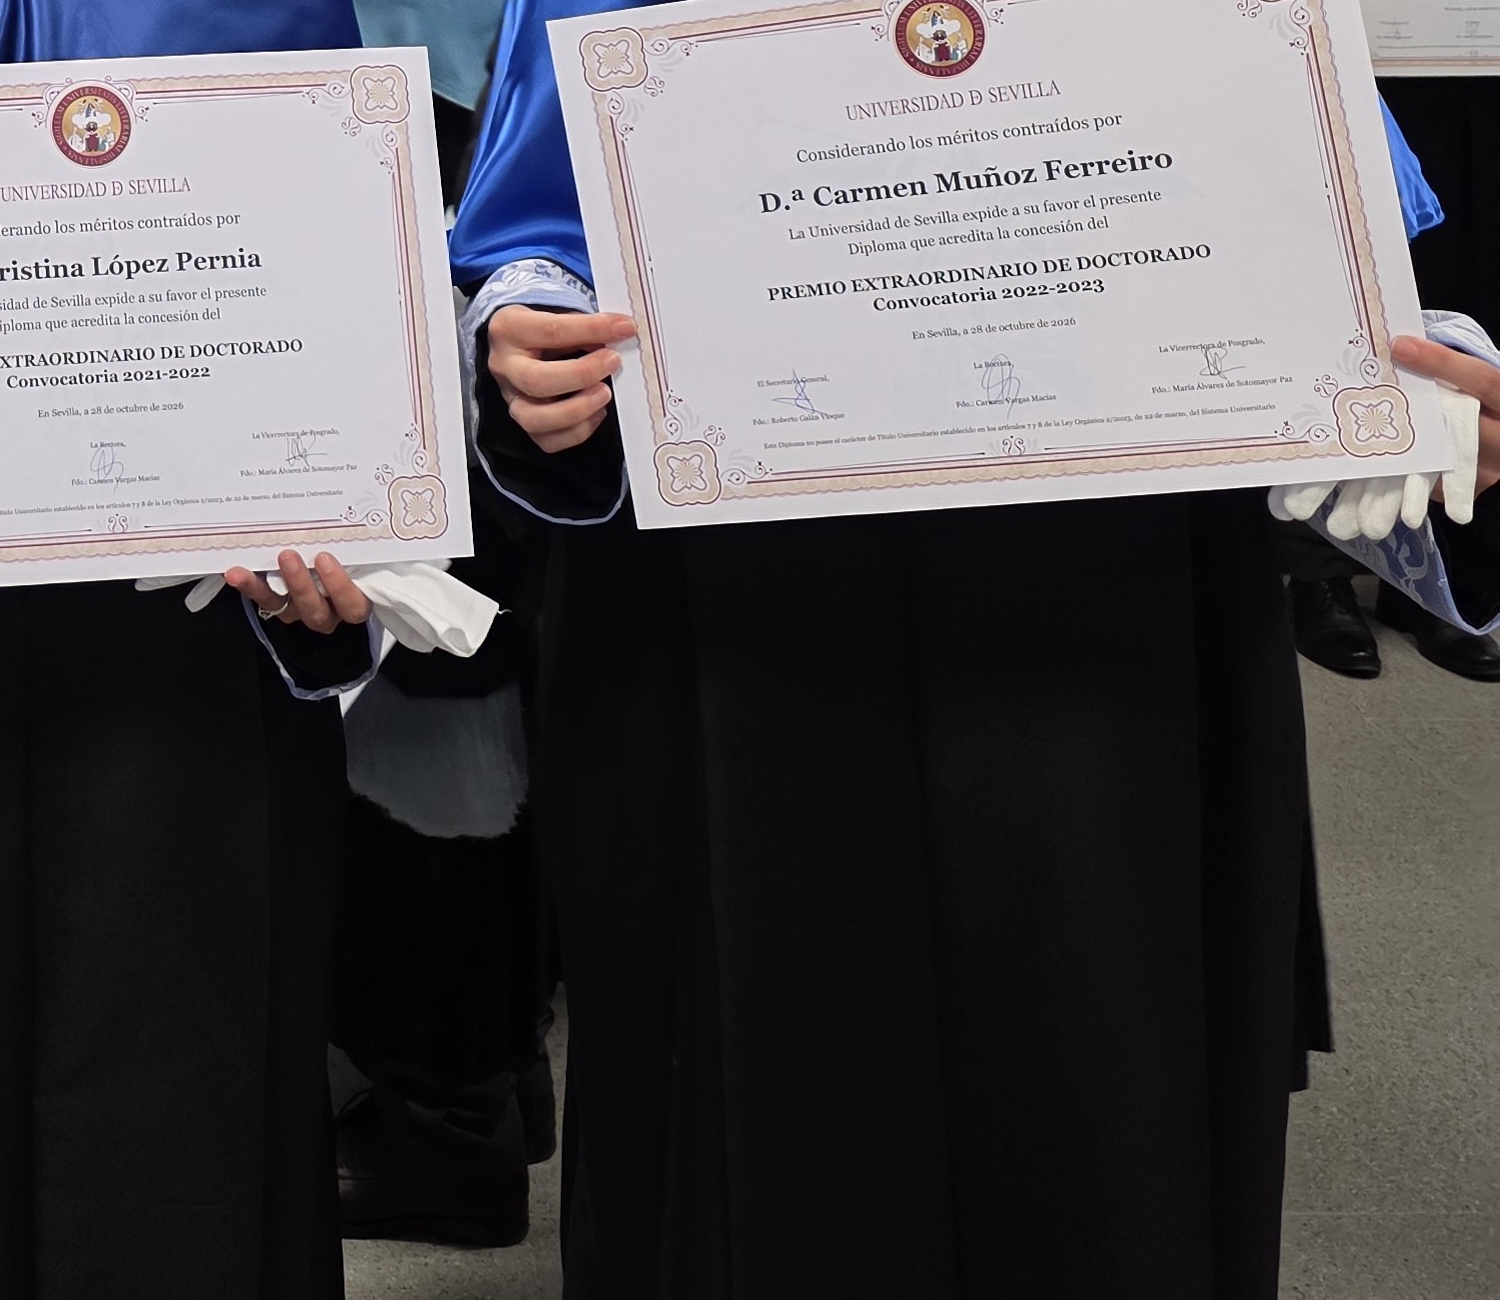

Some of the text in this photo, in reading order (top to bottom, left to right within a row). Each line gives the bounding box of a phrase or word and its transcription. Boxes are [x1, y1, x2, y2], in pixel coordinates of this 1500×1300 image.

[845, 91, 965, 121] UNIVERSIDAD
[987, 79, 1061, 104] SEVILLA
[796, 114, 1123, 163] Considerando los méritos contraídos por
[0, 181, 107, 203] UNIVERSIDAD
[128, 177, 191, 196] SEVILLA
[812, 180, 929, 207] Carmen
[932, 166, 1038, 194] Muñoz
[1042, 149, 1173, 182] Ferreiro
[54, 219, 76, 234] los
[79, 217, 135, 233] méritos
[137, 212, 213, 230] contraídos
[215, 214, 241, 229] por
[788, 190, 1162, 240] La Universidad de Sevilla expide a su favor el presente
[847, 215, 1109, 257] Diploma que acredita la concesión del
[91, 254, 170, 281] López
[175, 247, 262, 272] Pernia
[767, 243, 1211, 301] PREMIO EXTRAORDINARIO DE DOCTORADO
[32, 296, 48, 310] de
[50, 293, 92, 309] Sevilla
[94, 291, 136, 308] expide
[138, 294, 146, 304] a
[148, 293, 163, 303] su
[165, 289, 198, 302] favor
[200, 287, 212, 300] el
[214, 286, 267, 302] presente
[872, 278, 1105, 312] Convocatoria 2022-2023
[44, 319, 69, 333] que
[70, 313, 121, 328] acredita
[122, 312, 136, 325] la
[137, 308, 199, 324] concesión
[201, 307, 221, 321] del
[912, 330, 926, 340] En
[926, 326, 961, 339] Sevilla,
[969, 324, 984, 335] 28
[984, 323, 998, 333] de
[998, 320, 1036, 332] octubre
[1036, 318, 1050, 328] de
[1050, 316, 1077, 327] 2026
[159, 345, 186, 360] DE
[189, 338, 303, 358] DOCTORADO
[6, 366, 211, 389] Convocatoria 2021-2022
[37, 401, 185, 419] En Sevilla, a 28 de octubre de 2026
